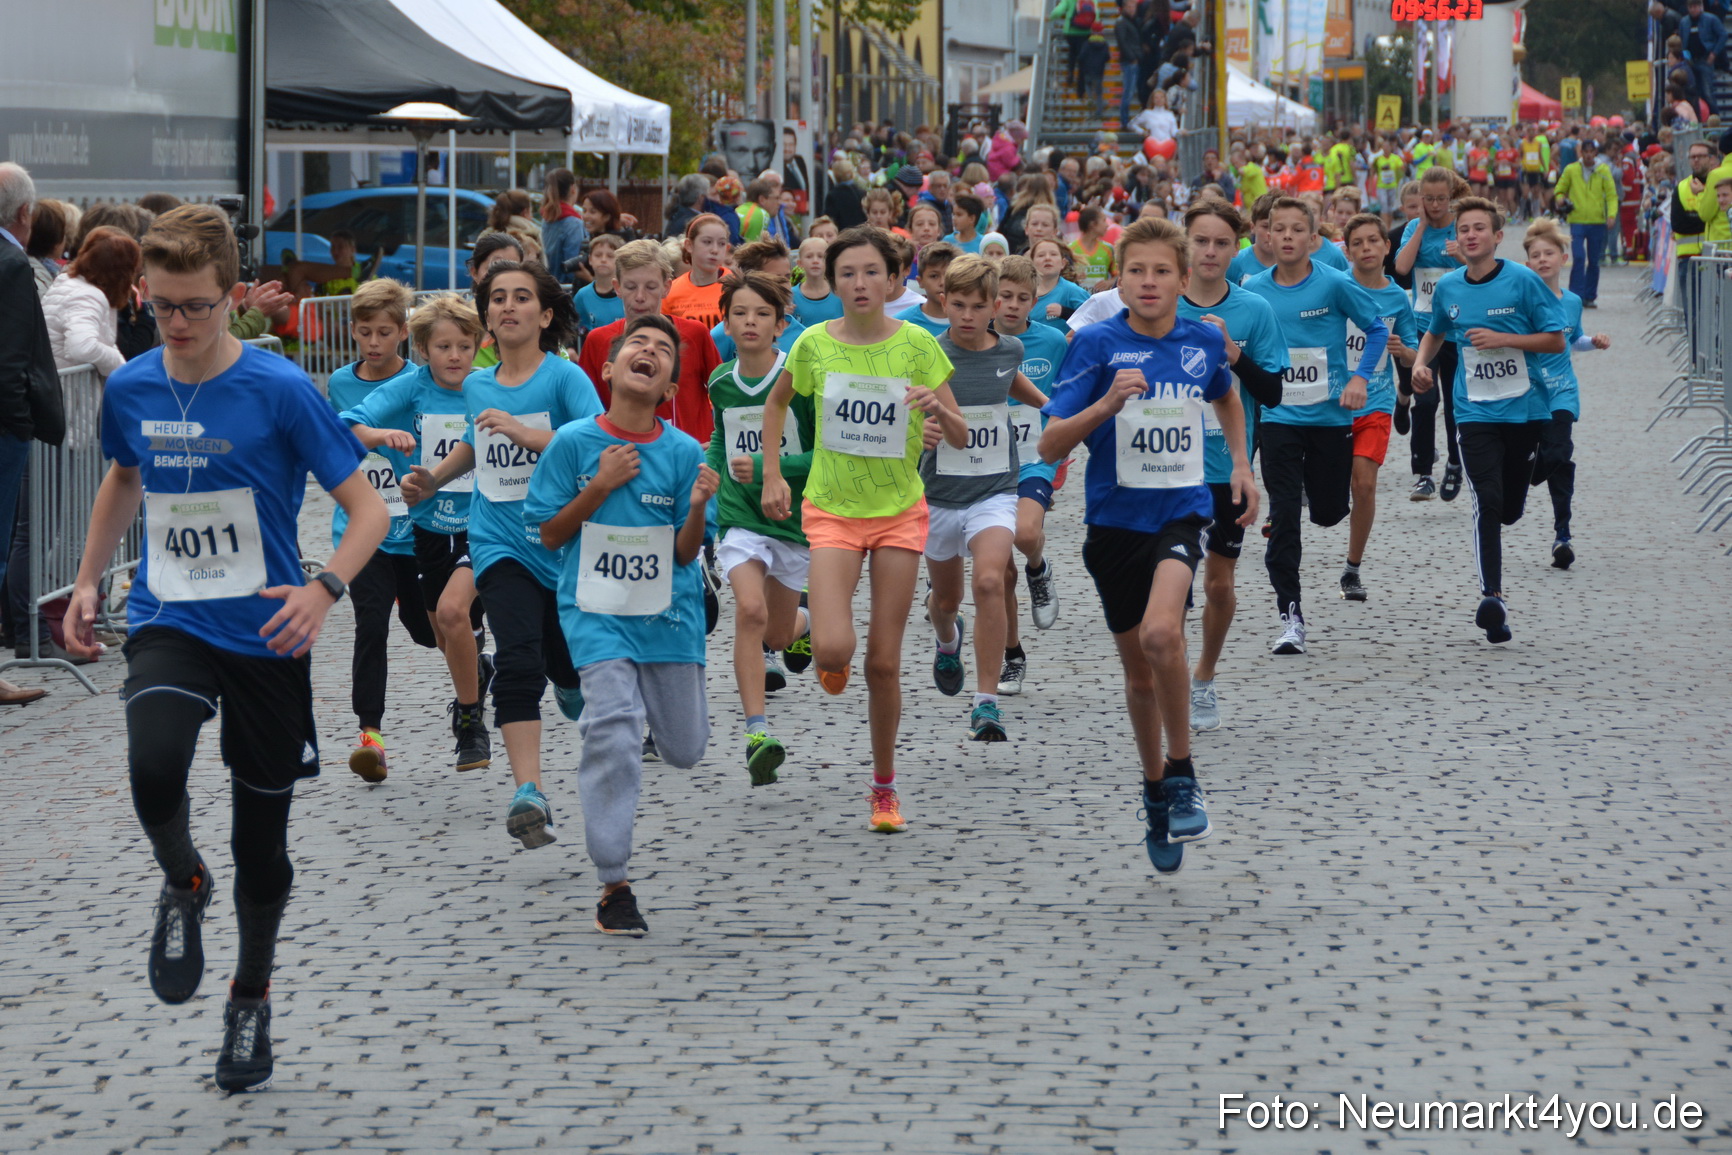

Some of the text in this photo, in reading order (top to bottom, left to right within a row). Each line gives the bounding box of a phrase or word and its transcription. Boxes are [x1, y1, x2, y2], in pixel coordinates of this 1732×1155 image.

[1567, 87, 1576, 100] B
[1382, 105, 1394, 121] A
[1300, 306, 1329, 318] BOCK
[1487, 307, 1516, 316] BOCK
[1346, 335, 1366, 352] 40
[1022, 363, 1049, 375] Hervis
[1281, 366, 1318, 383] 040
[1474, 358, 1518, 380] 4036
[835, 399, 896, 426] 4004
[154, 423, 193, 435] HEUTE
[841, 430, 887, 445] Luca Ronja
[1131, 426, 1191, 454] 4005
[165, 438, 222, 452] MORGEN
[154, 455, 208, 468] BEWEGEN
[969, 456, 983, 464] Tim
[1141, 462, 1185, 473] Alexander
[165, 523, 239, 559] 4011
[594, 552, 659, 581] 4033
[188, 567, 225, 581] Tobias
